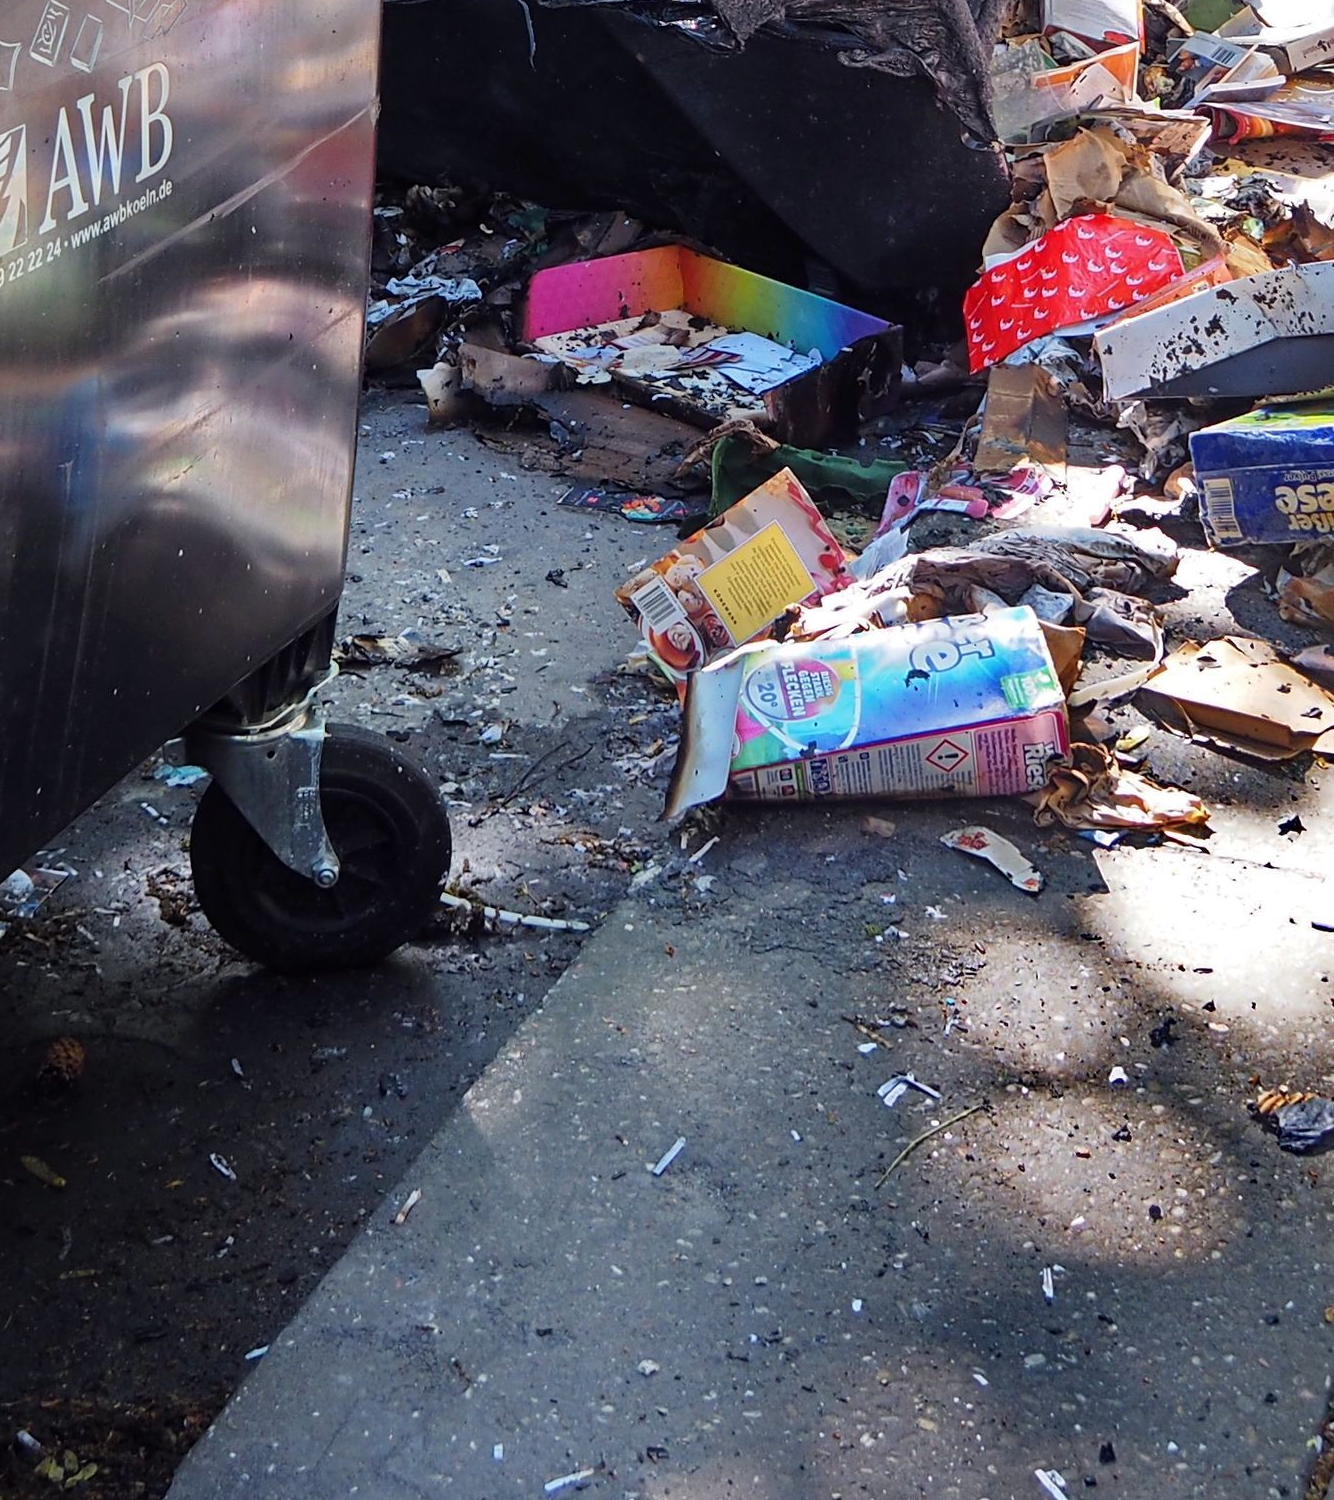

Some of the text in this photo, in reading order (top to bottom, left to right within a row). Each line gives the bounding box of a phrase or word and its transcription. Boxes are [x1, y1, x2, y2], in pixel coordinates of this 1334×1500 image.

[39, 62, 174, 235] AWB
[8, 261, 24, 282] 22
[27, 251, 44, 273] 22
[46, 241, 62, 264] 24
[71, 179, 174, 249] www.awbkoeln.de
[757, 682, 779, 708] 20°
[779, 661, 807, 718] FLECKEN
[797, 669, 817, 704] GEGEN
[809, 671, 826, 699] STARK
[820, 670, 836, 698] RIESIG
